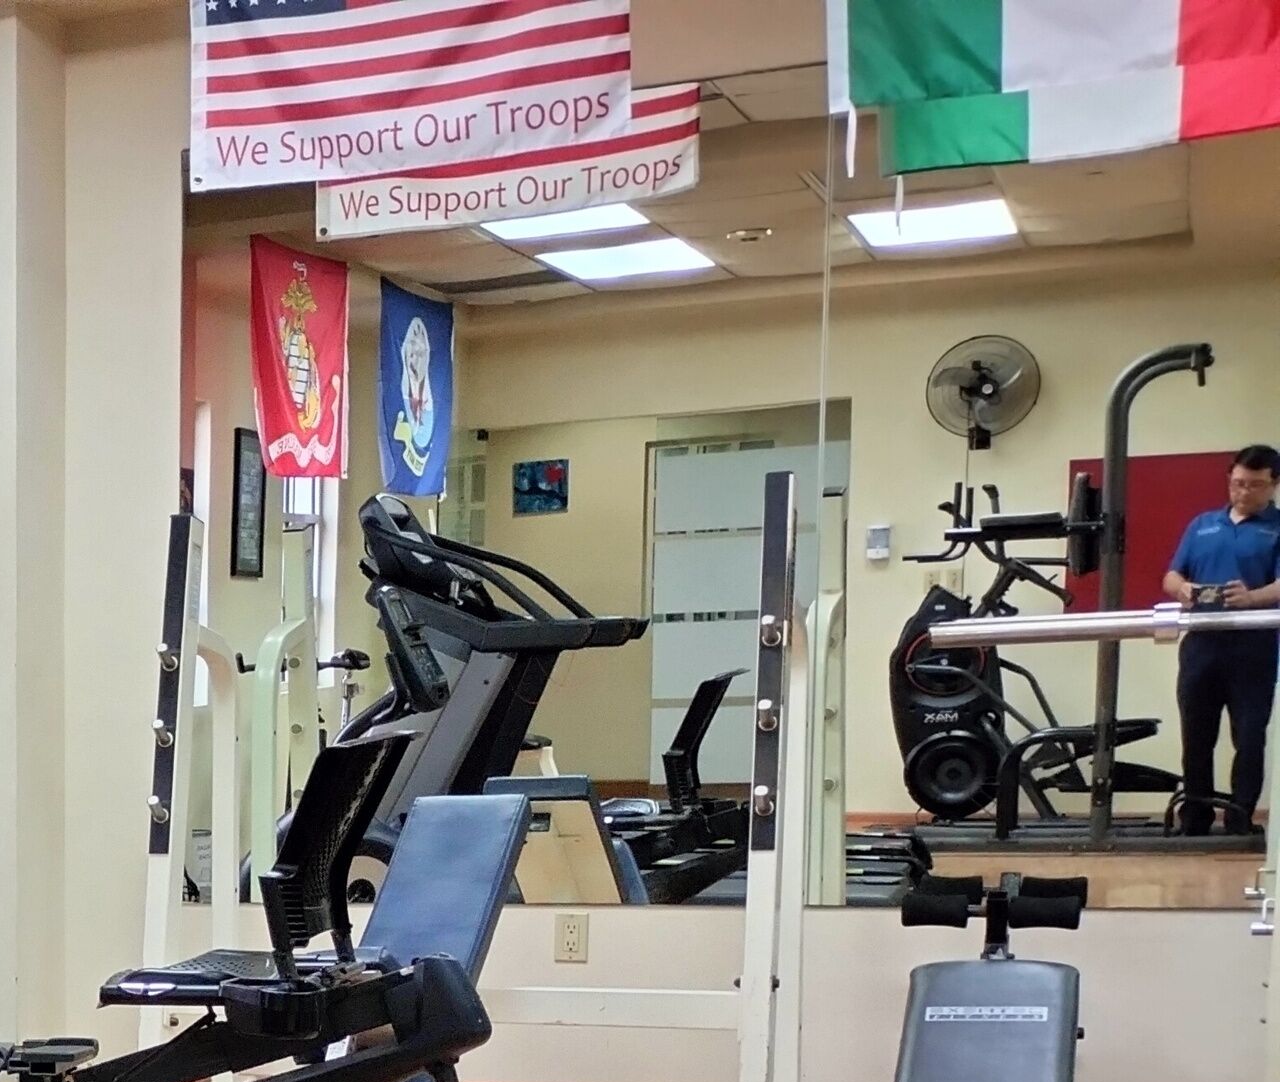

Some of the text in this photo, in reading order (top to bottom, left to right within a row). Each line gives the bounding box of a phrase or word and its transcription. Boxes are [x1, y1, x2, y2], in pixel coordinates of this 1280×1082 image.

[215, 91, 610, 171] We Support Our Troops
[339, 152, 683, 221] We Support Our Troops
